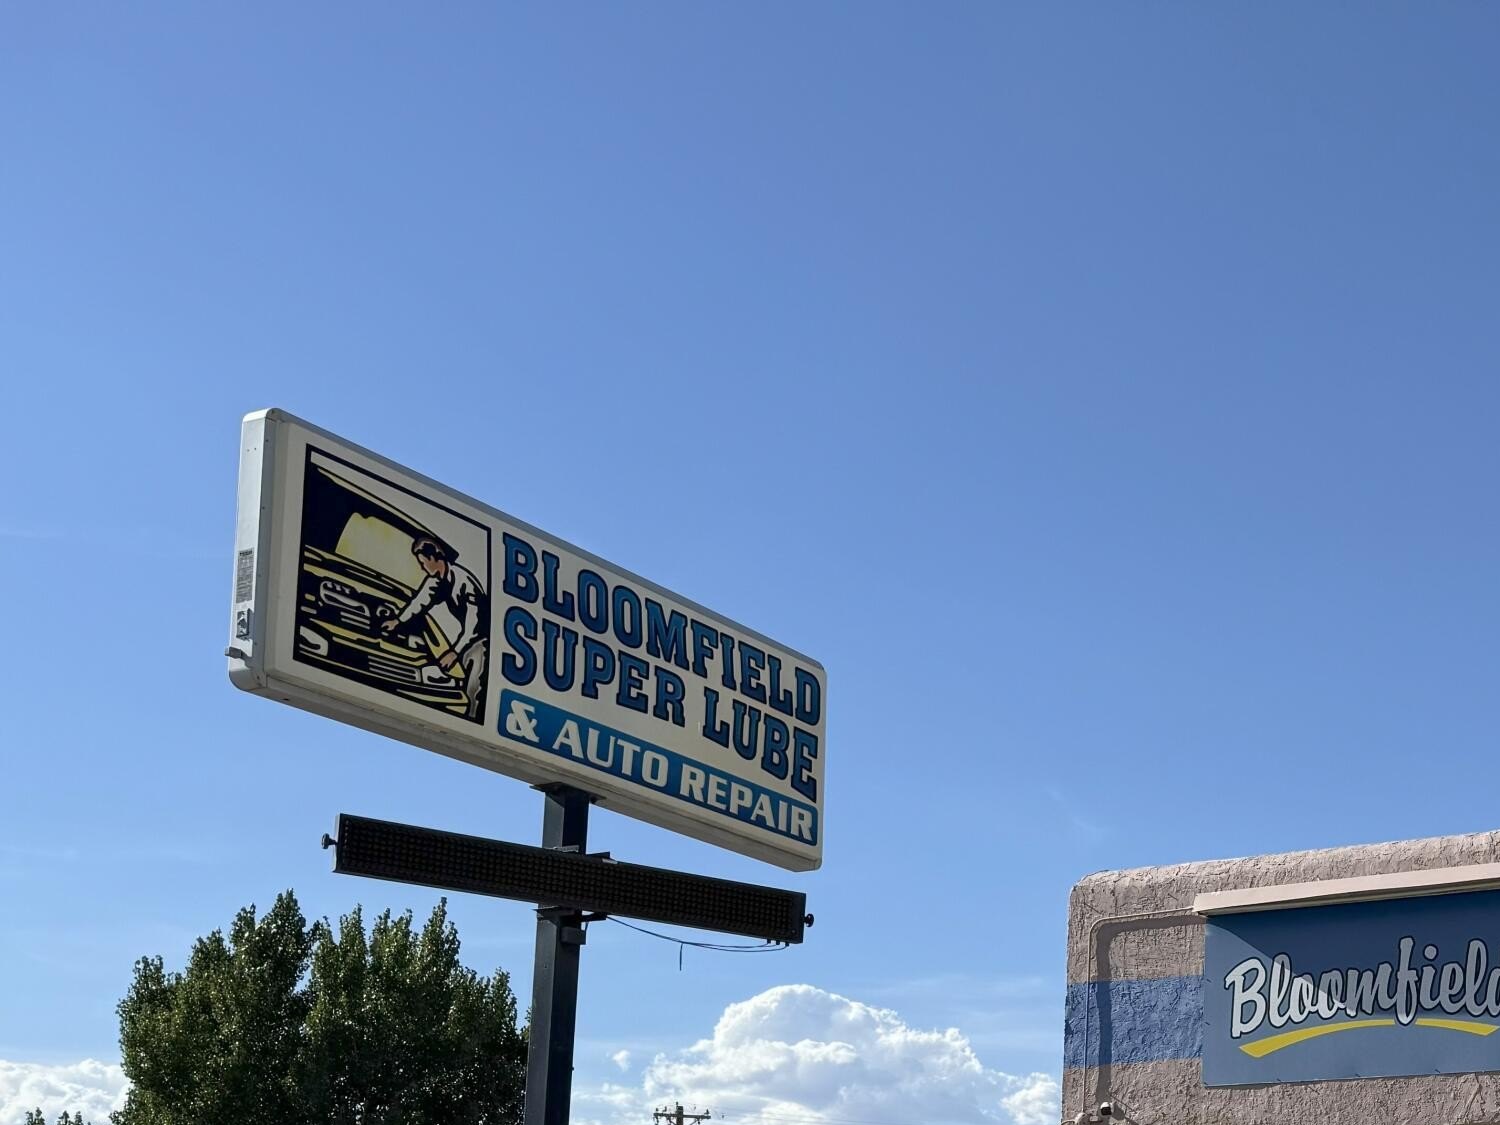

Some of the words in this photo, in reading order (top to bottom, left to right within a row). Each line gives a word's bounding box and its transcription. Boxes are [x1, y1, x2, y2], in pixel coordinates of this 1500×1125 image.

[502, 532, 821, 726] BLOOMFIELD
[502, 606, 686, 727] SUPER
[702, 686, 818, 803] LUBE
[505, 700, 540, 742] &
[552, 719, 669, 788] AUTO
[679, 763, 814, 841] REPAIR
